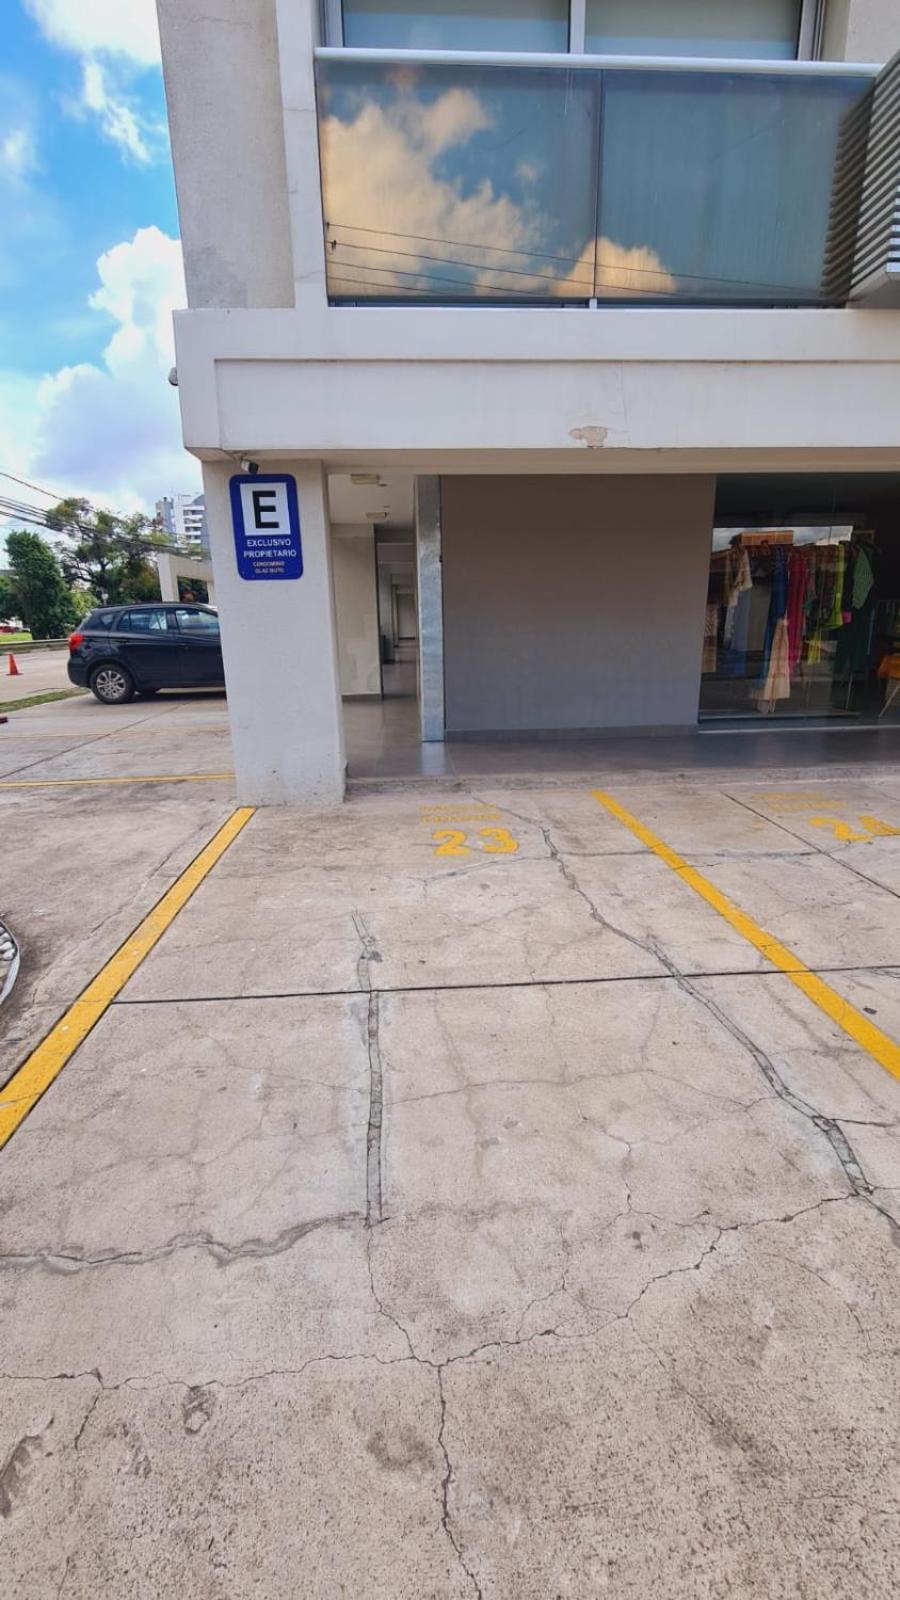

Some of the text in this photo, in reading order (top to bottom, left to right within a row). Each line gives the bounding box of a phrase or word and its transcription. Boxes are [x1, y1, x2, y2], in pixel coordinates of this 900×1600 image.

[252, 490, 279, 528] E
[247, 538, 292, 547] EXCLUSIVO
[243, 549, 297, 558] PROPIETARIO
[432, 828, 519, 857] 23
